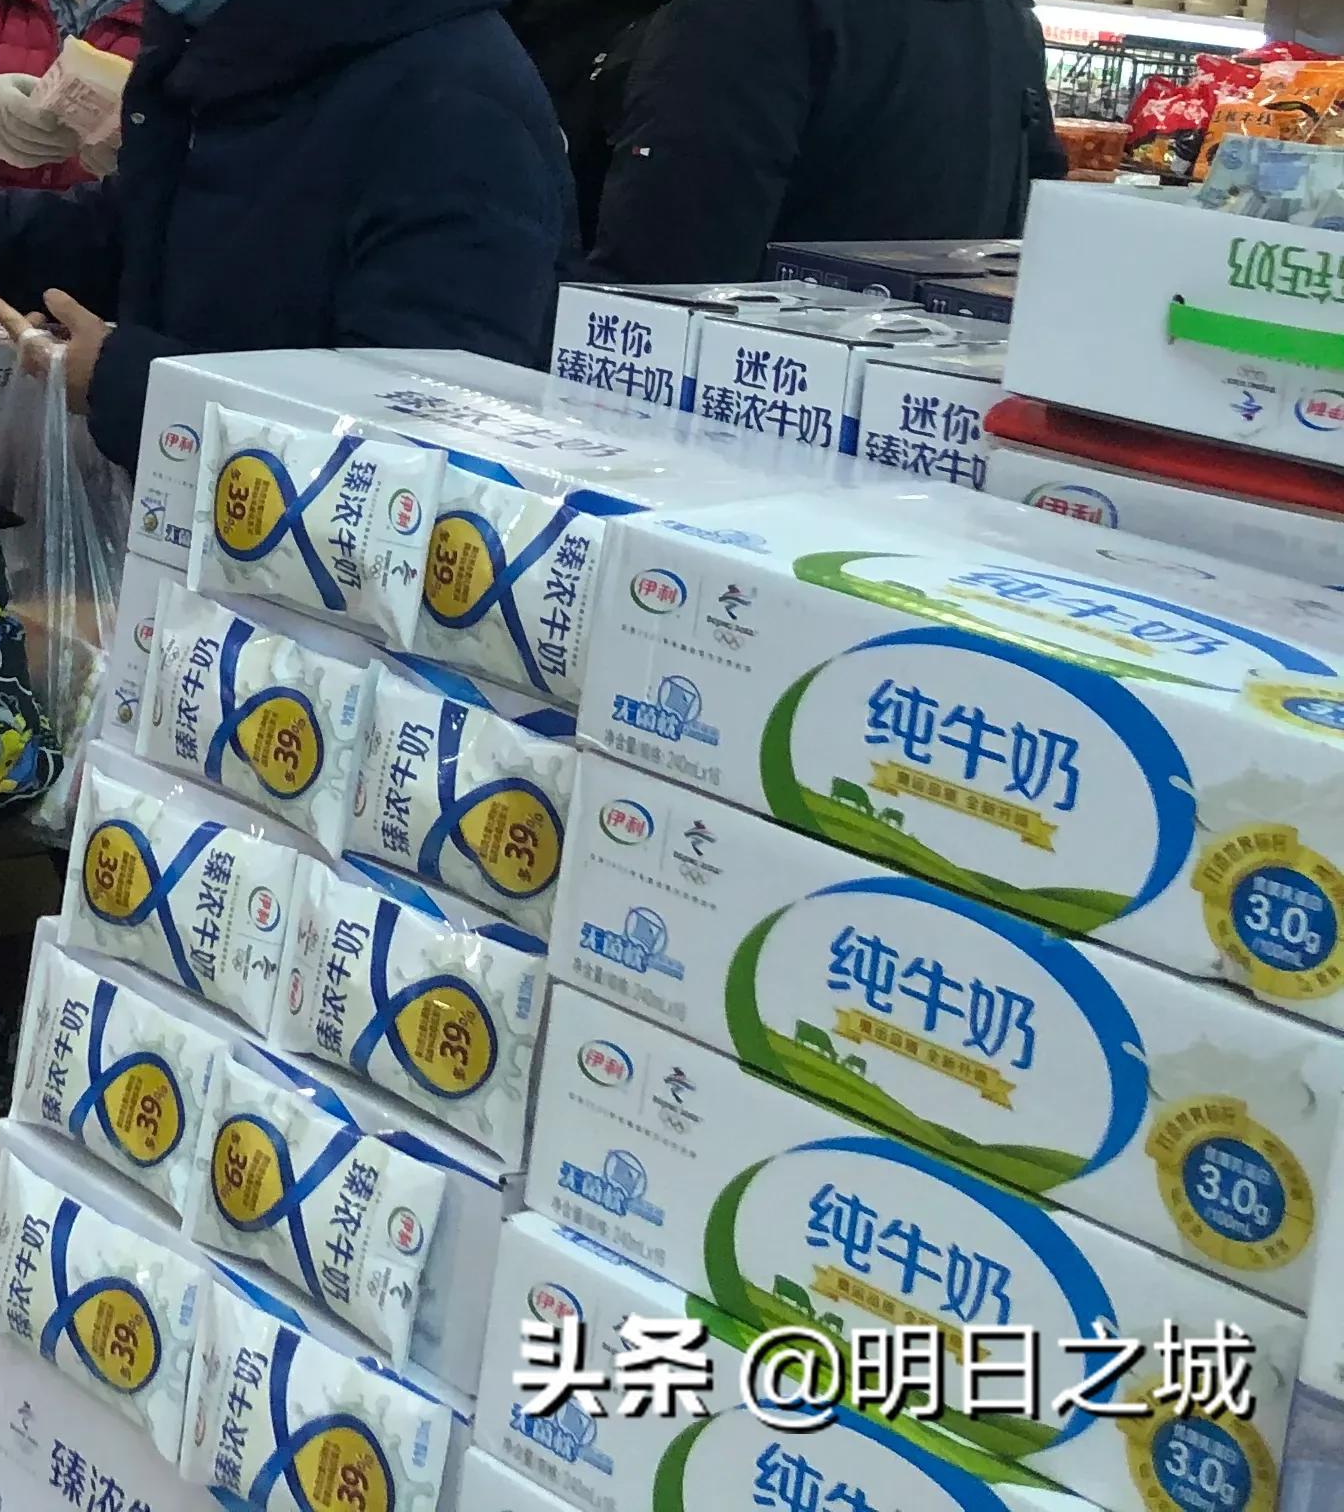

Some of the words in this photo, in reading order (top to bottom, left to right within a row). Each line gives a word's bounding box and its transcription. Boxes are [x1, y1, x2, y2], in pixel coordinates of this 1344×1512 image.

[1227, 236, 1344, 304] 钙奶
[585, 310, 653, 359] 迷你
[556, 346, 674, 408] 臻浓牛奶
[732, 345, 808, 396] 迷你
[164, 432, 194, 453] 伊利
[701, 383, 833, 449] 臻浓牛奶
[899, 391, 982, 445] 迷你
[327, 458, 379, 590] 臻浓牛奶
[395, 493, 415, 529] 伊利
[536, 532, 592, 679] 臻浓牛奶
[638, 577, 679, 605] 伊利
[173, 636, 221, 763] 臻浓牛奶
[863, 678, 1080, 812] 纯牛奶
[380, 720, 435, 858] 臻浓牛奶
[607, 808, 646, 838] 伊利
[188, 846, 237, 983] 臻浓牛奶
[1243, 893, 1322, 955] 3.0g
[315, 917, 371, 1058] 臻浓牛奶
[826, 925, 1036, 1071] 纯牛奶
[41, 996, 90, 1125] 臻浓牛奶
[584, 1047, 626, 1081] 伊利
[1196, 1162, 1270, 1227] 3.0g
[321, 1157, 380, 1305] 臻浓牛奶
[805, 1183, 1012, 1326] 纯牛奶
[6, 1213, 52, 1342] 臻浓牛奶
[534, 1291, 576, 1319] 伊利
[214, 1346, 269, 1492] 臻浓牛奶
[48, 1438, 151, 1512] 臻浓
